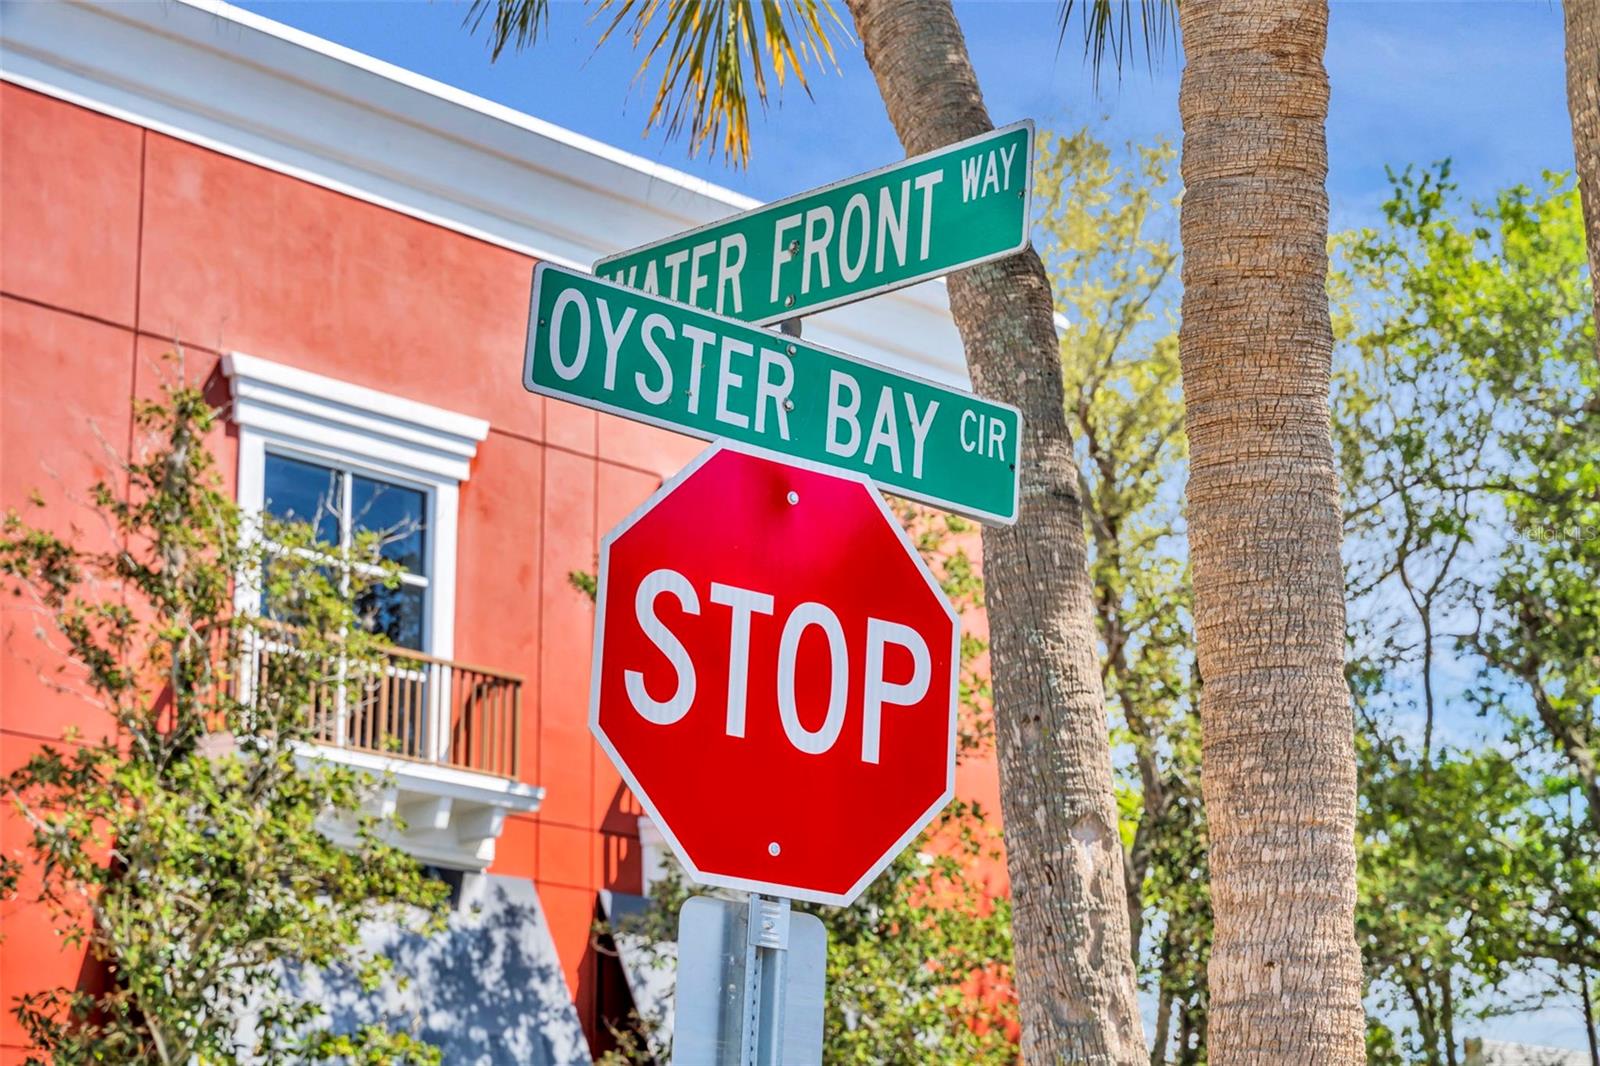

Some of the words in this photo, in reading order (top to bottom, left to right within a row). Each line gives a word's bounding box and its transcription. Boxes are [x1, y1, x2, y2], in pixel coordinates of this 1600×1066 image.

[769, 168, 944, 304] FRONT
[961, 142, 1018, 203] WAY
[548, 287, 795, 441] OYSTER
[825, 369, 940, 480] BAY
[959, 408, 1007, 463] CIR
[624, 568, 932, 765] STOP
